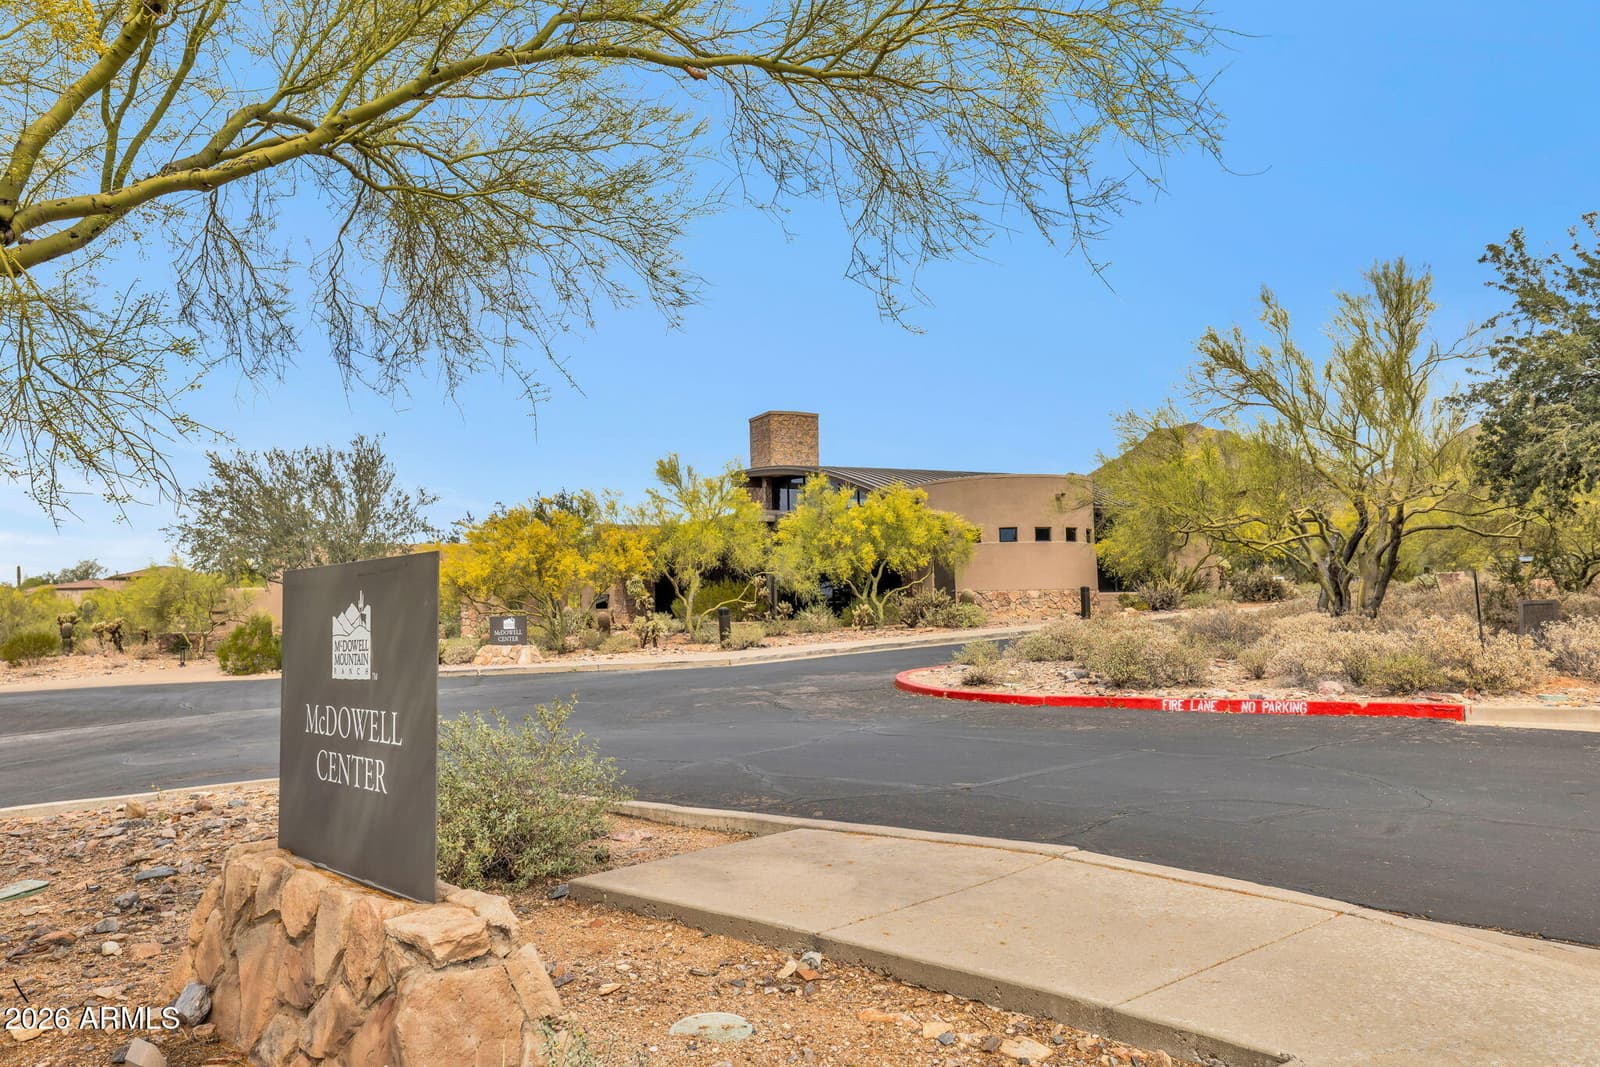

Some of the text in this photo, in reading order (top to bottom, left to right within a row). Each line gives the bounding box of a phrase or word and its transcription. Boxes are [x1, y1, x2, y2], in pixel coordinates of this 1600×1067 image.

[334, 653, 369, 666] MOUNTAIN
[1161, 699, 1217, 712] FIRE LANE
[1241, 701, 1308, 714] NO PARKING
[305, 703, 403, 746] McDOWELL
[316, 749, 388, 795] CENTER
